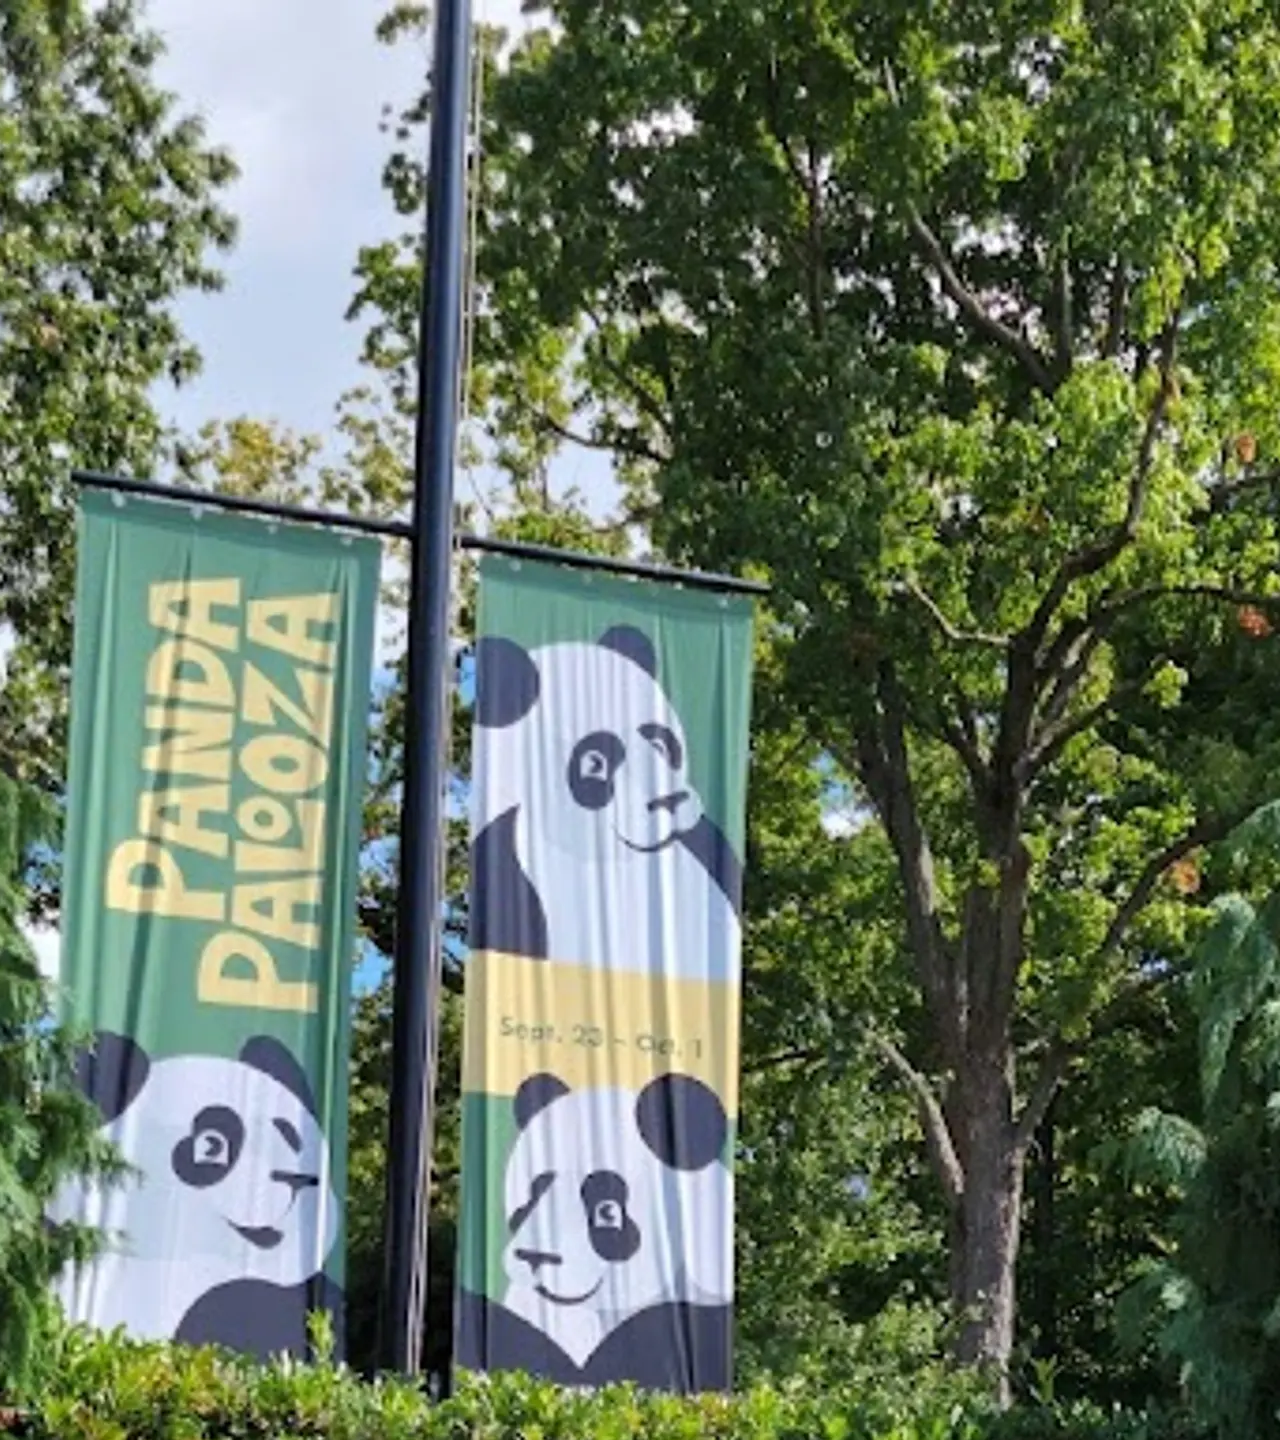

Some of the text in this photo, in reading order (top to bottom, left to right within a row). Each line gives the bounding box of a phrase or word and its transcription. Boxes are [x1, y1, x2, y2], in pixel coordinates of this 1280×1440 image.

[106, 577, 241, 922] PANDA
[197, 591, 341, 1014] PALOOZA
[500, 1016, 563, 1045] Sept.
[691, 1038, 702, 1060] 1
